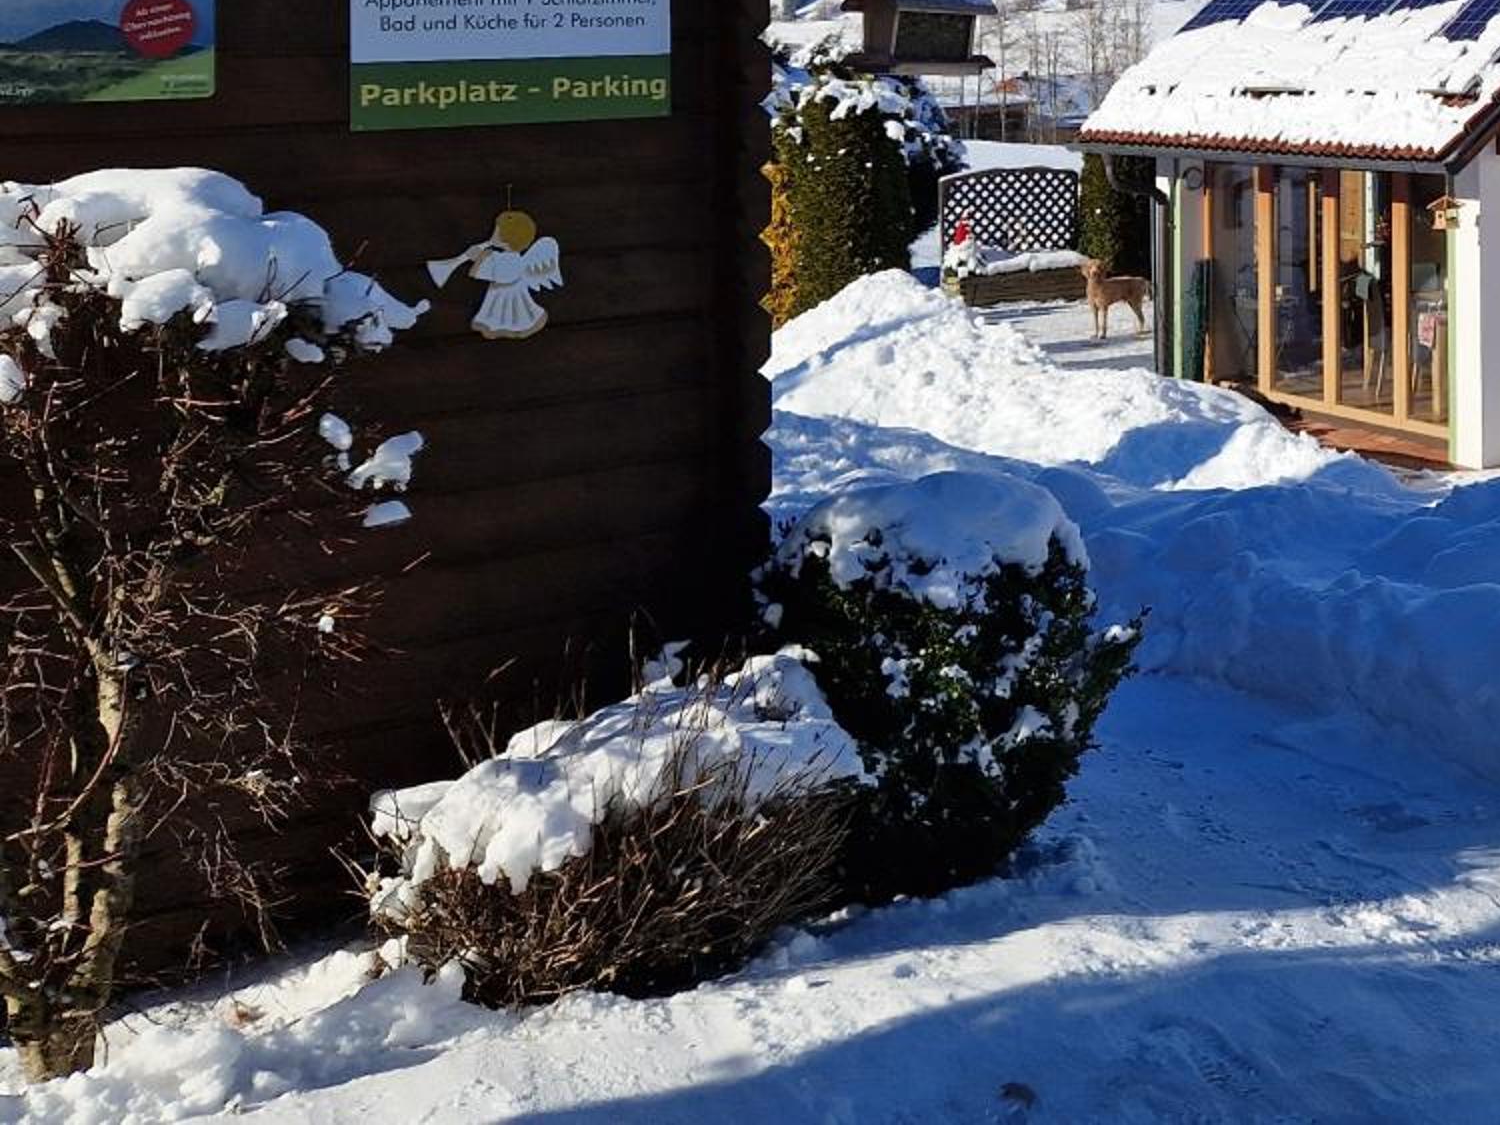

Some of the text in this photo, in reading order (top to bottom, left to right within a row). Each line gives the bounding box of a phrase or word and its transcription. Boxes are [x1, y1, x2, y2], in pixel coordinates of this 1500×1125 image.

[380, 13, 645, 32] Bad und Küche für 2 Personen
[361, 80, 518, 109] Parkplatz
[553, 75, 667, 100] Parking
